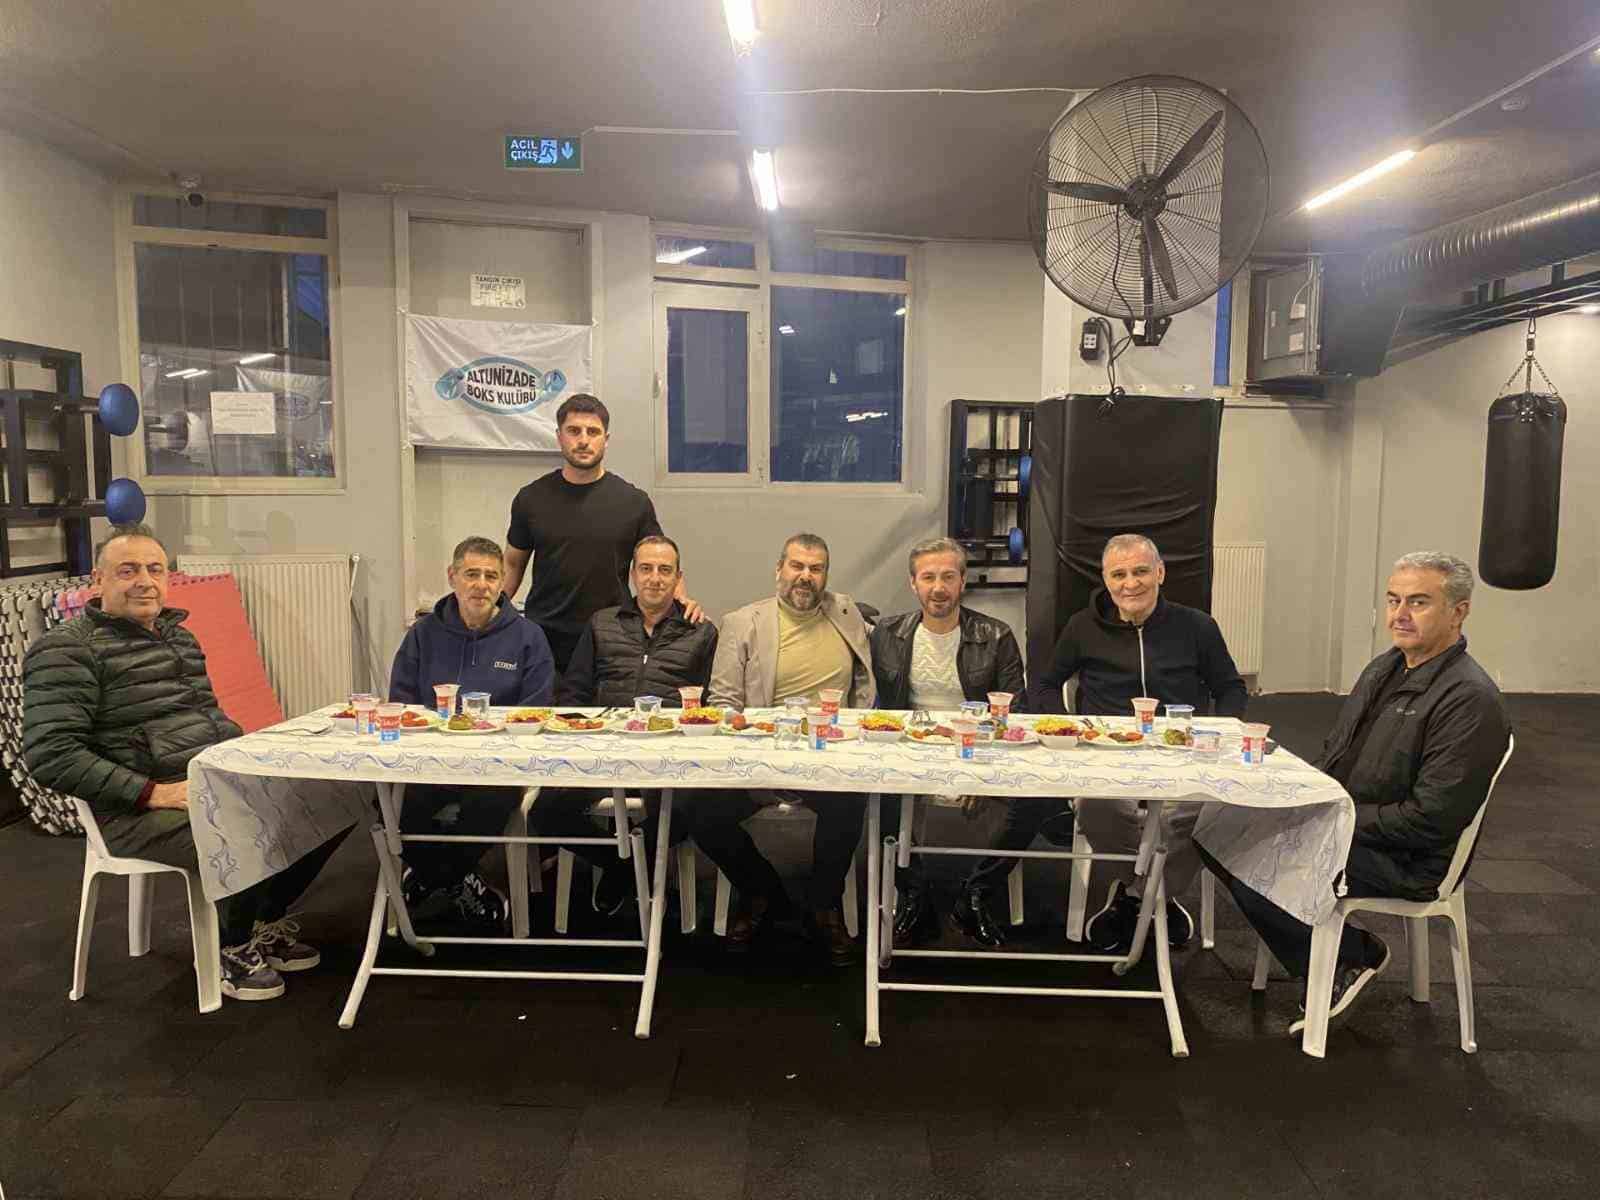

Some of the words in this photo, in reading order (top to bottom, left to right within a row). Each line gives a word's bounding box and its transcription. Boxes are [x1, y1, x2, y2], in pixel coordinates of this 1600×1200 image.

[467, 365, 536, 388] ALTUNİZADE
[467, 384, 494, 402] BOKS
[497, 387, 536, 405] KULÜBÜ
